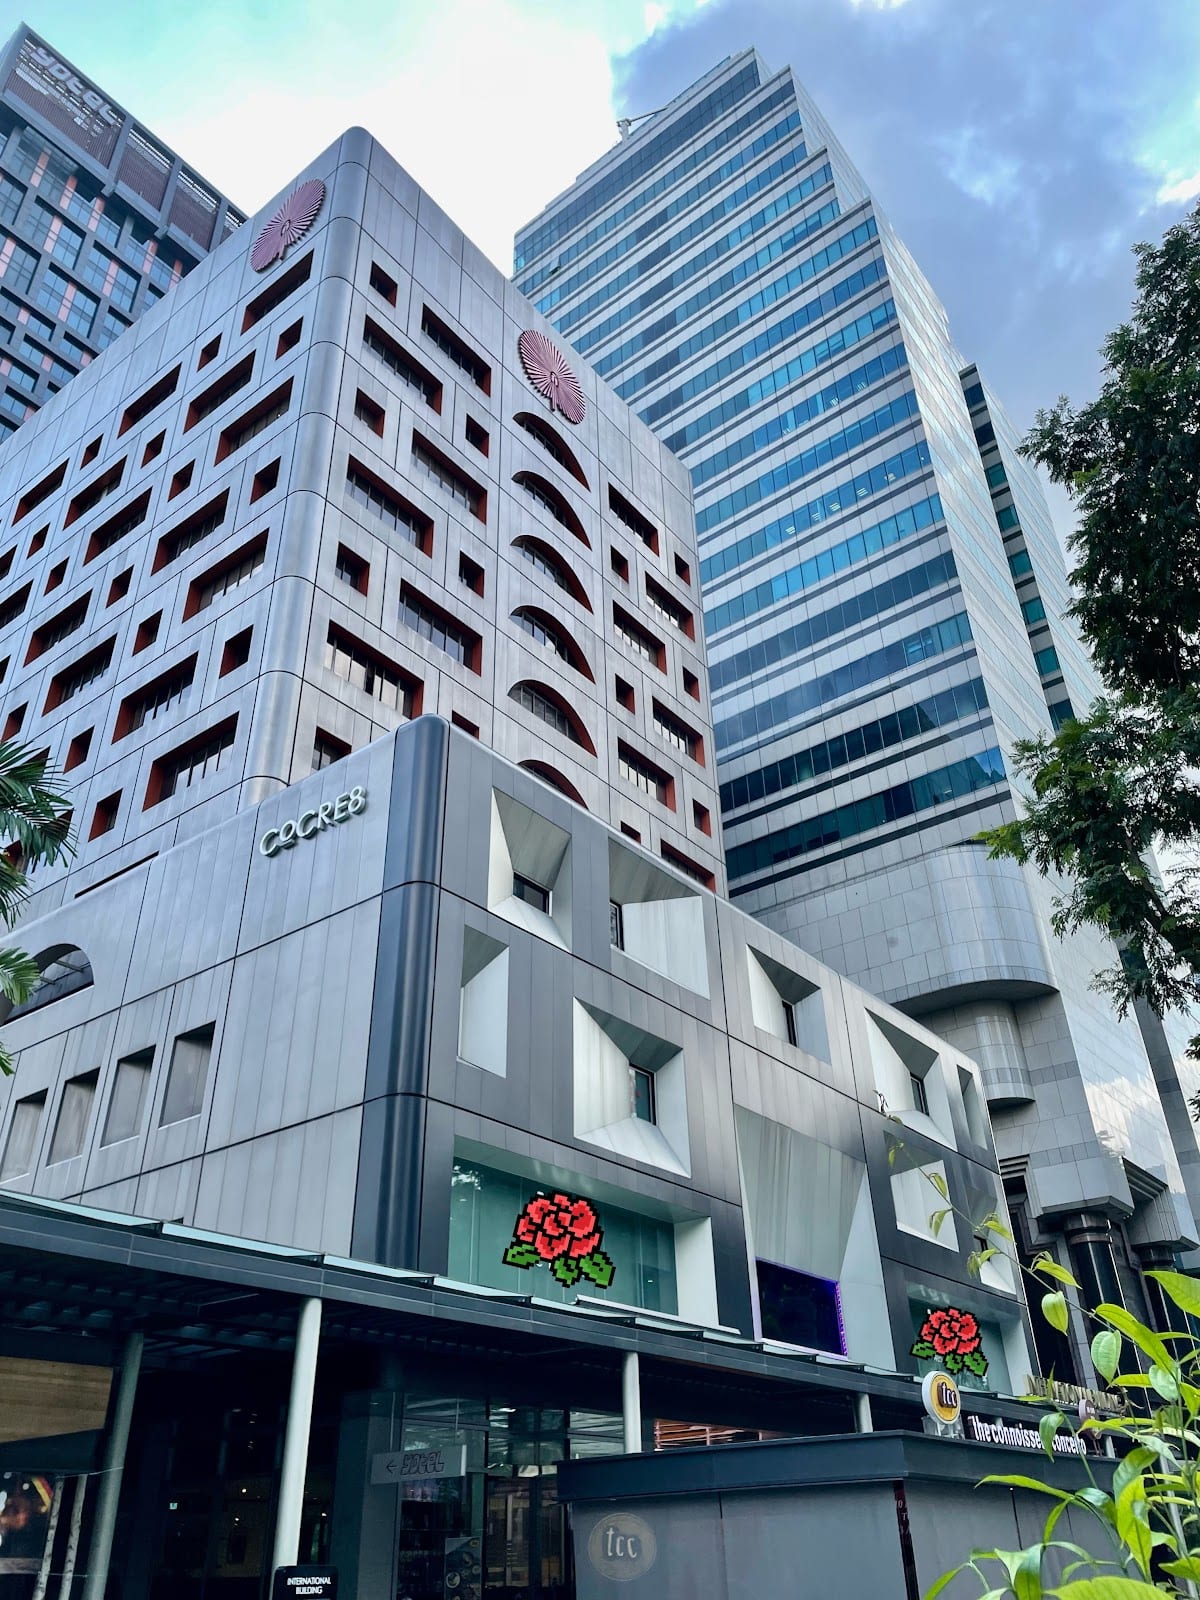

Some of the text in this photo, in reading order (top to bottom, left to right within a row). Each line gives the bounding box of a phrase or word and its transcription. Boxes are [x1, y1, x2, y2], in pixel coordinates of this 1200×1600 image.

[939, 1381, 957, 1408] tcc
[968, 1415, 991, 1442] the
[606, 1526, 638, 1558] tcc
[287, 1576, 332, 1586] INTERNATIONAL
[295, 1585, 323, 1595] BUILDING
